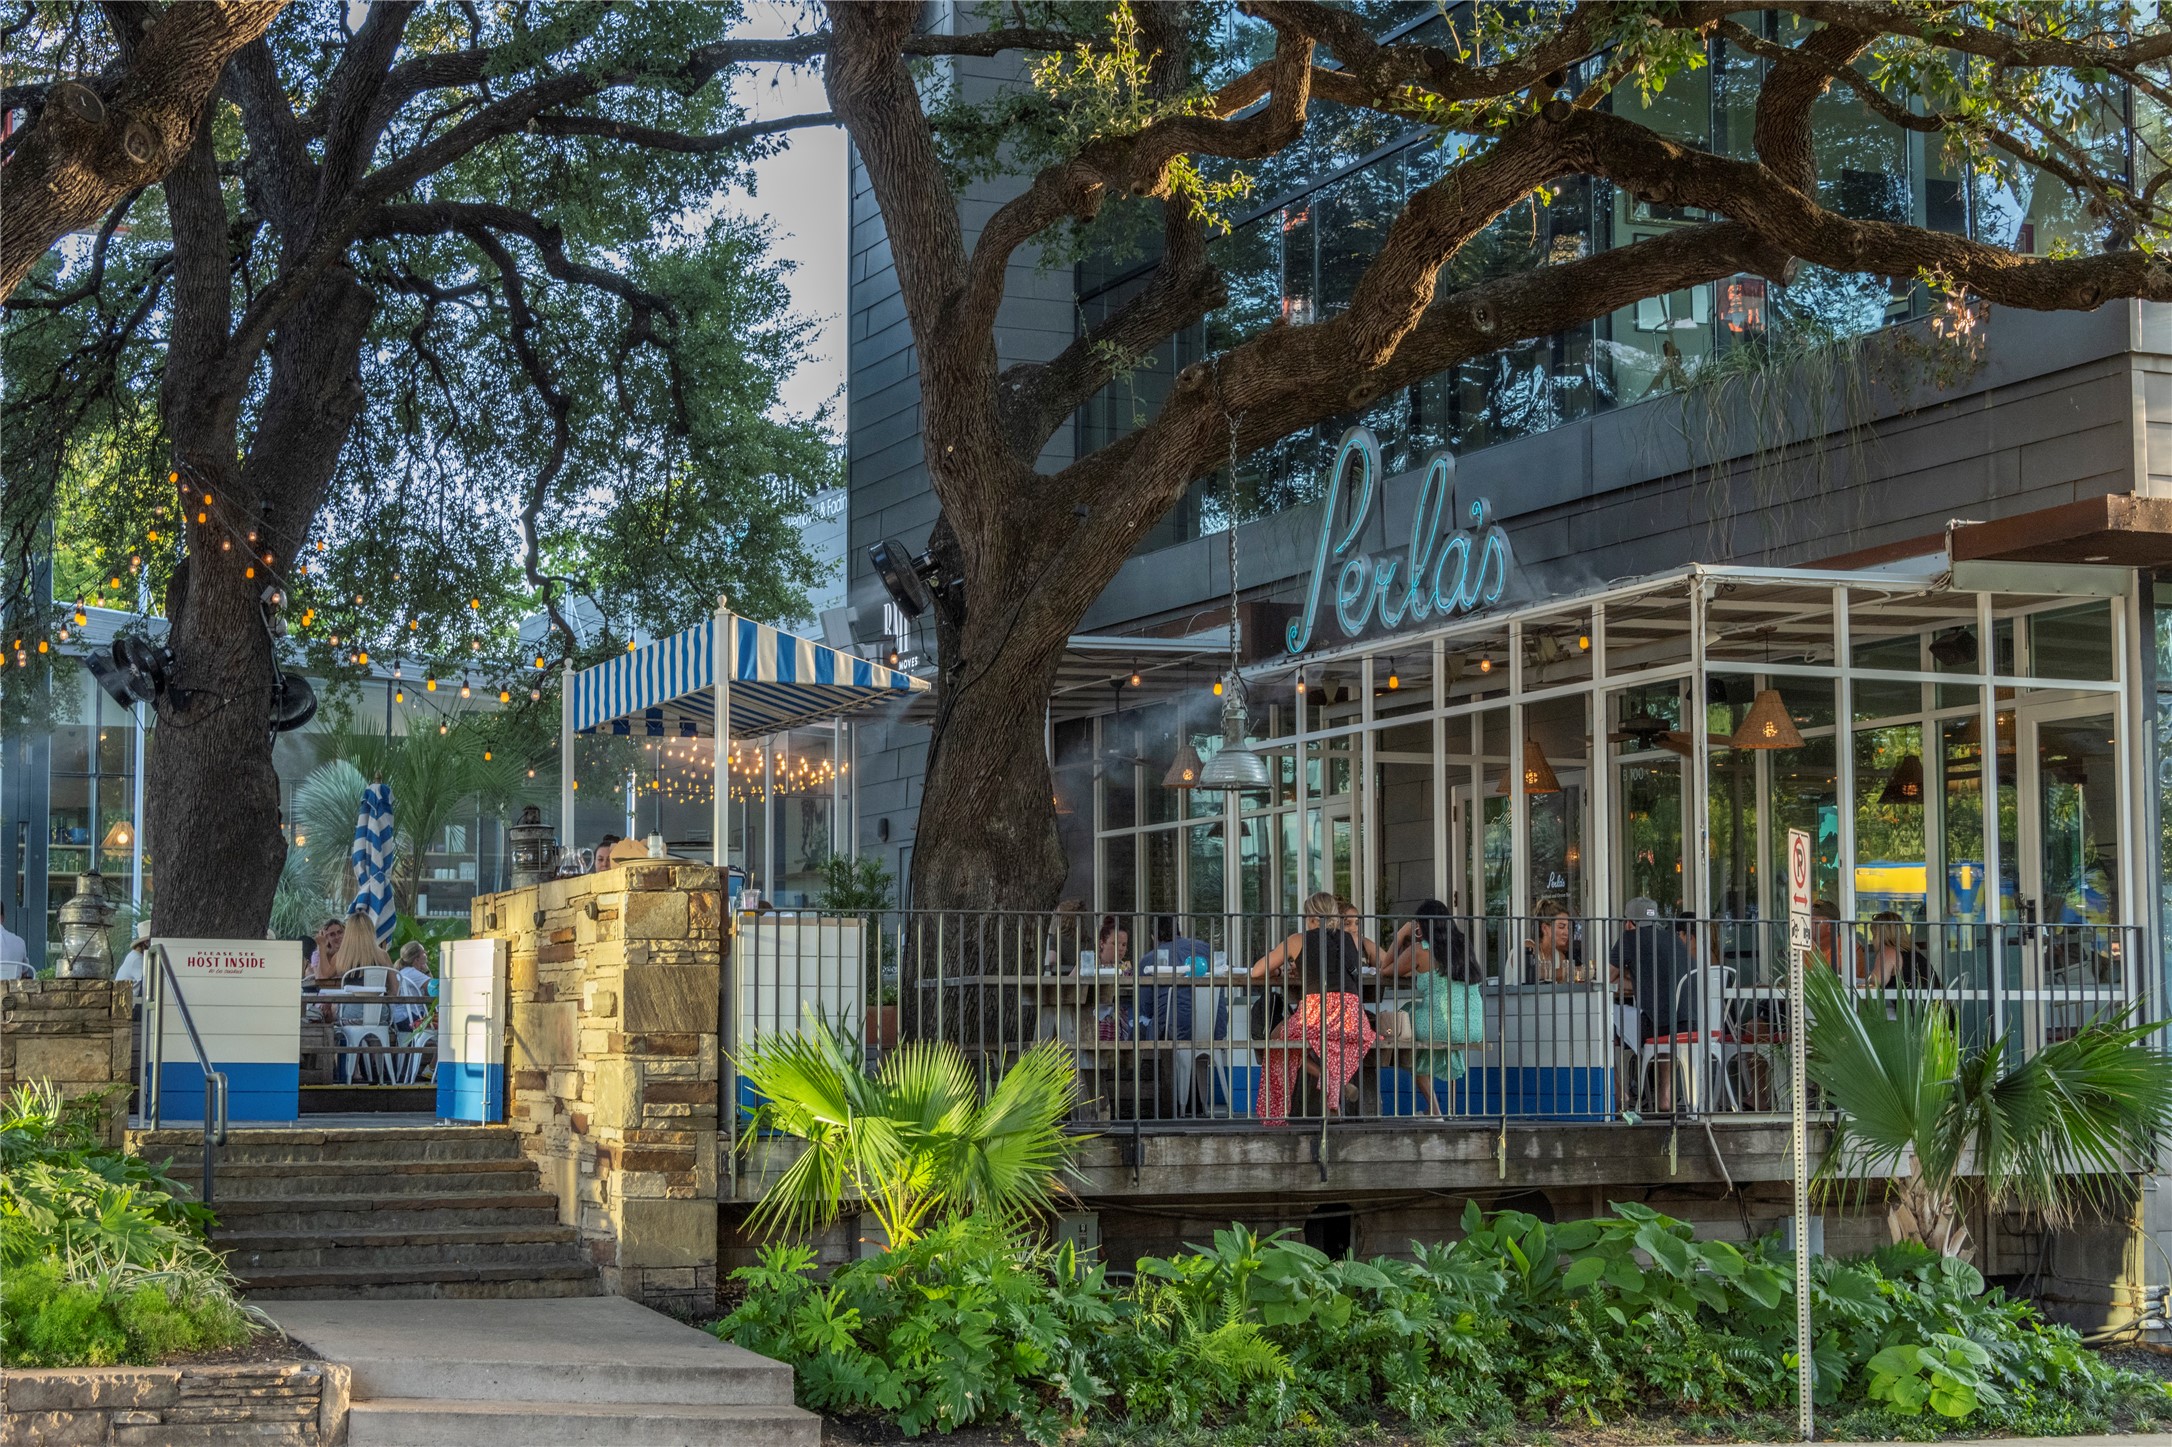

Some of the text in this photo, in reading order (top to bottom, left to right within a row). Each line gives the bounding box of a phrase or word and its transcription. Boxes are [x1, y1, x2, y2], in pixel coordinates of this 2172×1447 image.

[1286, 426, 1513, 655] Perla's
[187, 956, 266, 969] HOST INSIDE
